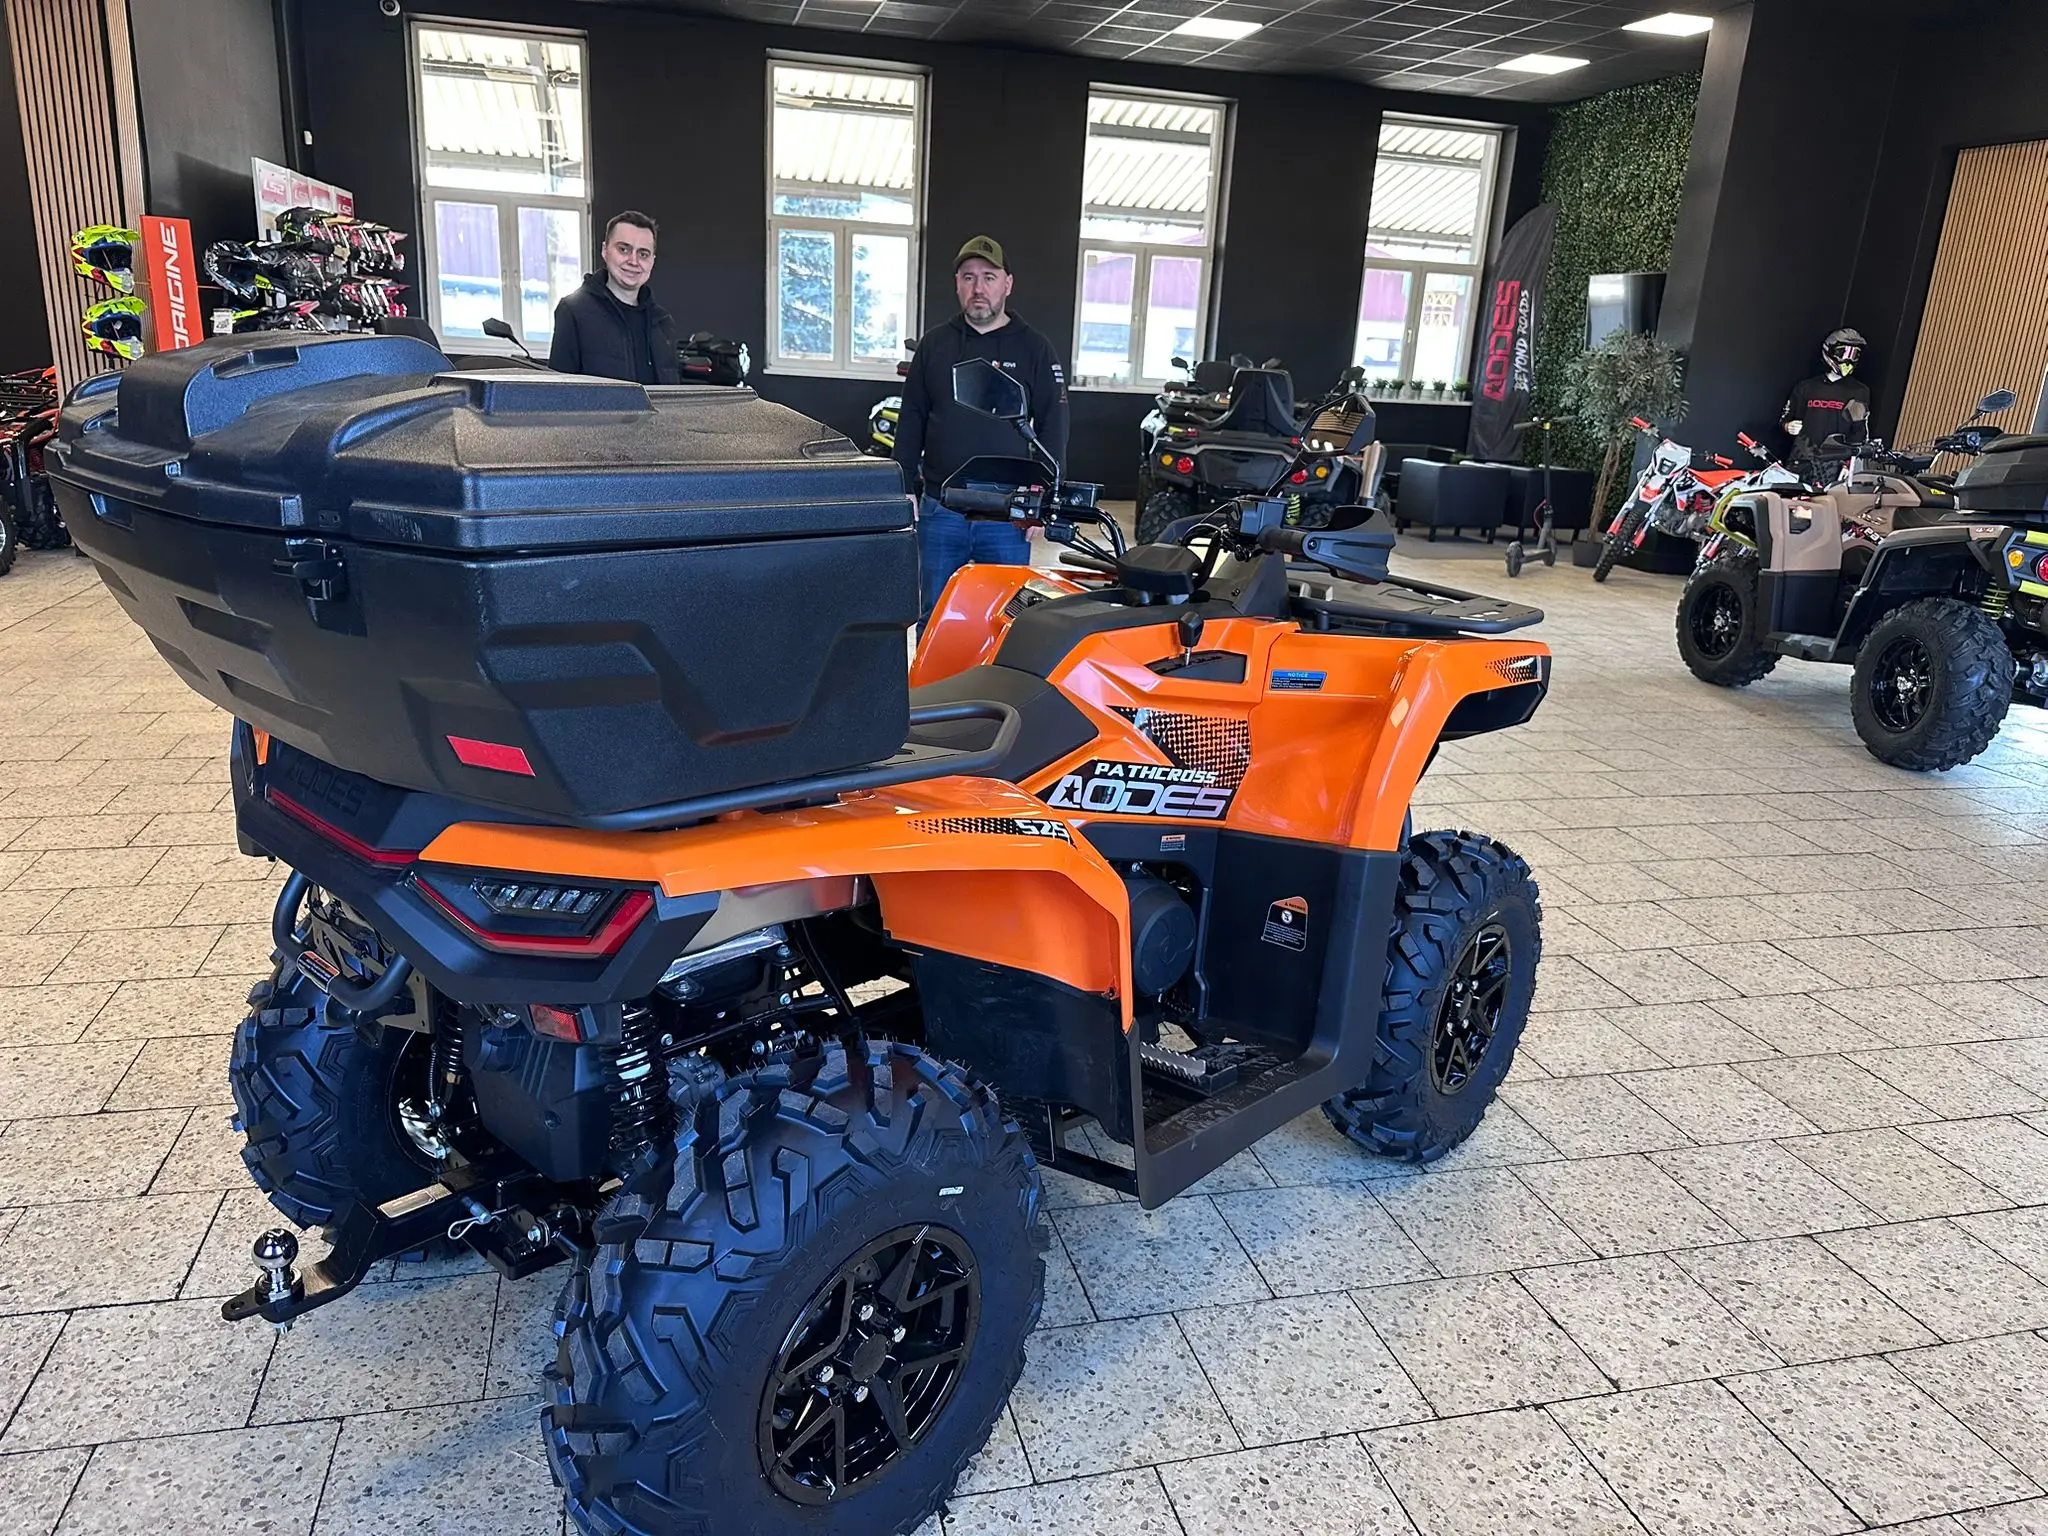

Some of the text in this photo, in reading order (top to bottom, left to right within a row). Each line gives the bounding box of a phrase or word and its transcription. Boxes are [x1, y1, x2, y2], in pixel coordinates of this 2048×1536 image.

[263, 179, 285, 196] LS2
[1483, 280, 1521, 401] AODES
[1513, 289, 1529, 393] BEYOND ROADS
[1094, 762, 1219, 784] PATHCROSS
[1046, 775, 1233, 818] AODES
[1014, 819, 1070, 842] 525
